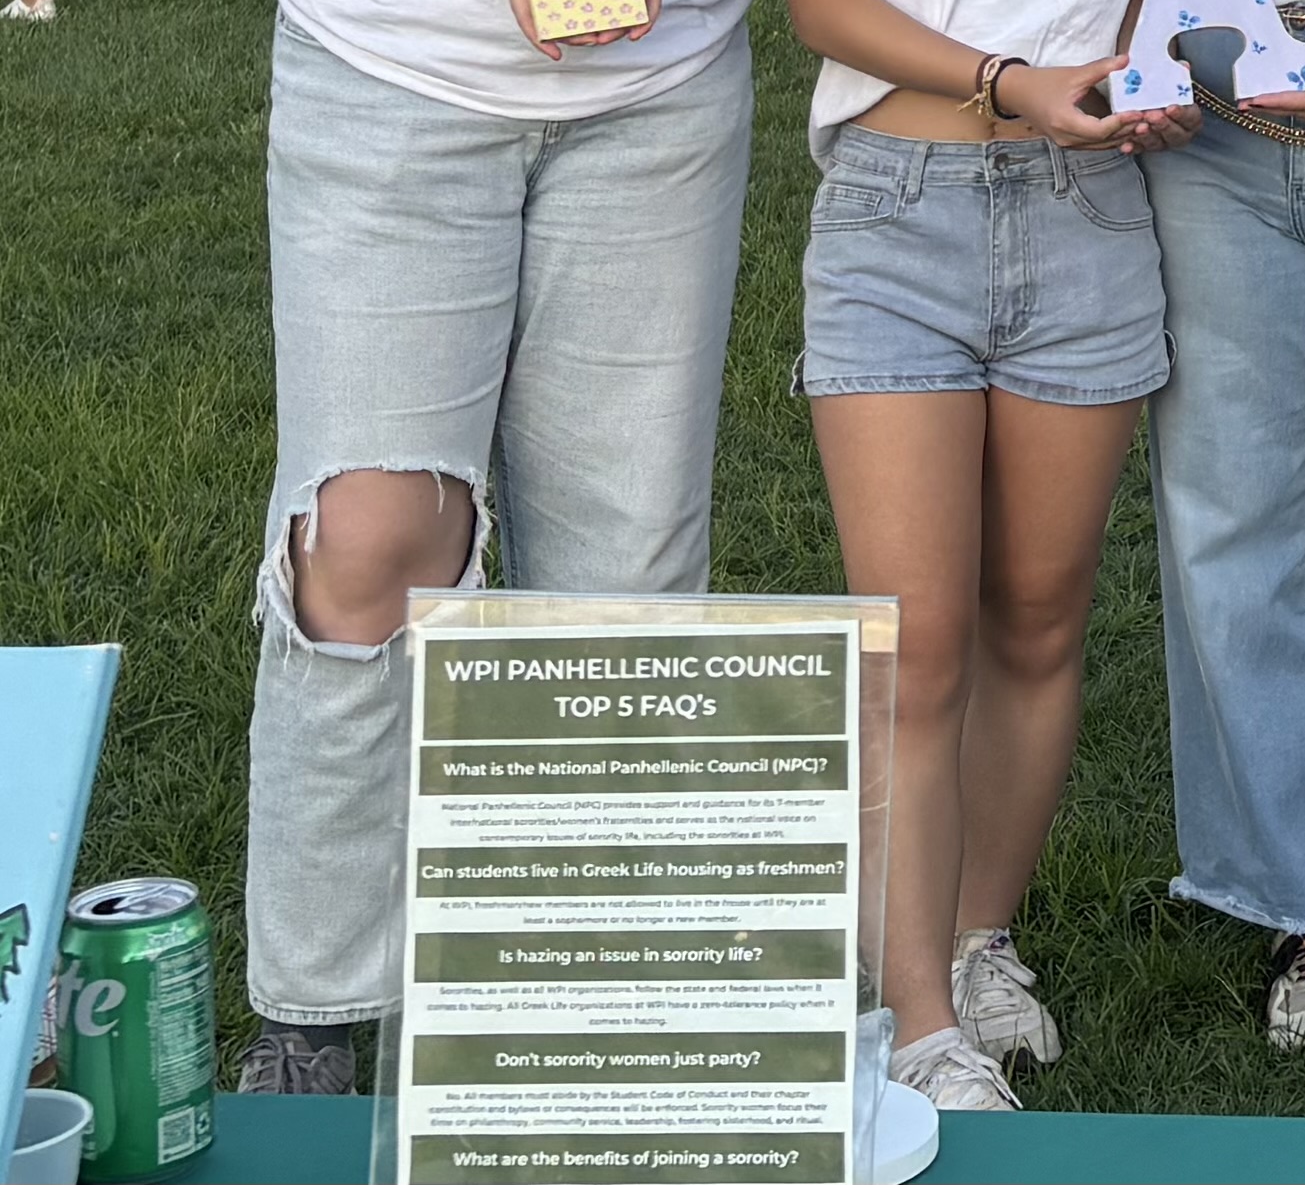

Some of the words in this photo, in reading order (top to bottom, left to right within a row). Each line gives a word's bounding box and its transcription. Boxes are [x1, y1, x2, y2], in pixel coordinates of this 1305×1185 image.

[443, 660, 499, 681] WPI
[507, 656, 700, 680] PANHELLENIC
[704, 654, 832, 677] COUNCIL
[554, 696, 611, 717] TOP
[617, 695, 633, 716] 5
[638, 693, 716, 719] FAQ's
[443, 762, 486, 775] What
[490, 761, 504, 775] is
[507, 761, 534, 775] the
[538, 760, 605, 774] National
[610, 759, 703, 773] Panhellenic
[707, 758, 768, 772] Council
[772, 757, 827, 774] (NPC)?
[421, 865, 452, 878] Can
[456, 864, 527, 878] students
[531, 863, 558, 877] live
[563, 862, 577, 876] in
[581, 862, 629, 876] Greek
[634, 862, 663, 876] Life
[667, 861, 732, 879] housing
[736, 864, 753, 875] as
[757, 861, 845, 874] freshmen?
[499, 949, 513, 962] Is
[516, 947, 571, 965] hazing
[575, 951, 595, 961] an
[598, 947, 640, 961] issue
[644, 947, 659, 961] in
[662, 947, 726, 964] sorority
[728, 946, 763, 961] life?
[496, 1052, 538, 1066] Don't
[544, 1051, 605, 1069] sorority
[610, 1054, 669, 1065] women
[673, 1051, 703, 1068] just
[709, 1051, 759, 1068] party?
[454, 1151, 497, 1165] What
[502, 1155, 528, 1165] are
[532, 1151, 559, 1165] the
[564, 1150, 629, 1165] benefits
[633, 1150, 649, 1165] of
[652, 1149, 709, 1167] joining
[714, 1153, 722, 1164] a
[728, 1149, 798, 1167] sorority?
